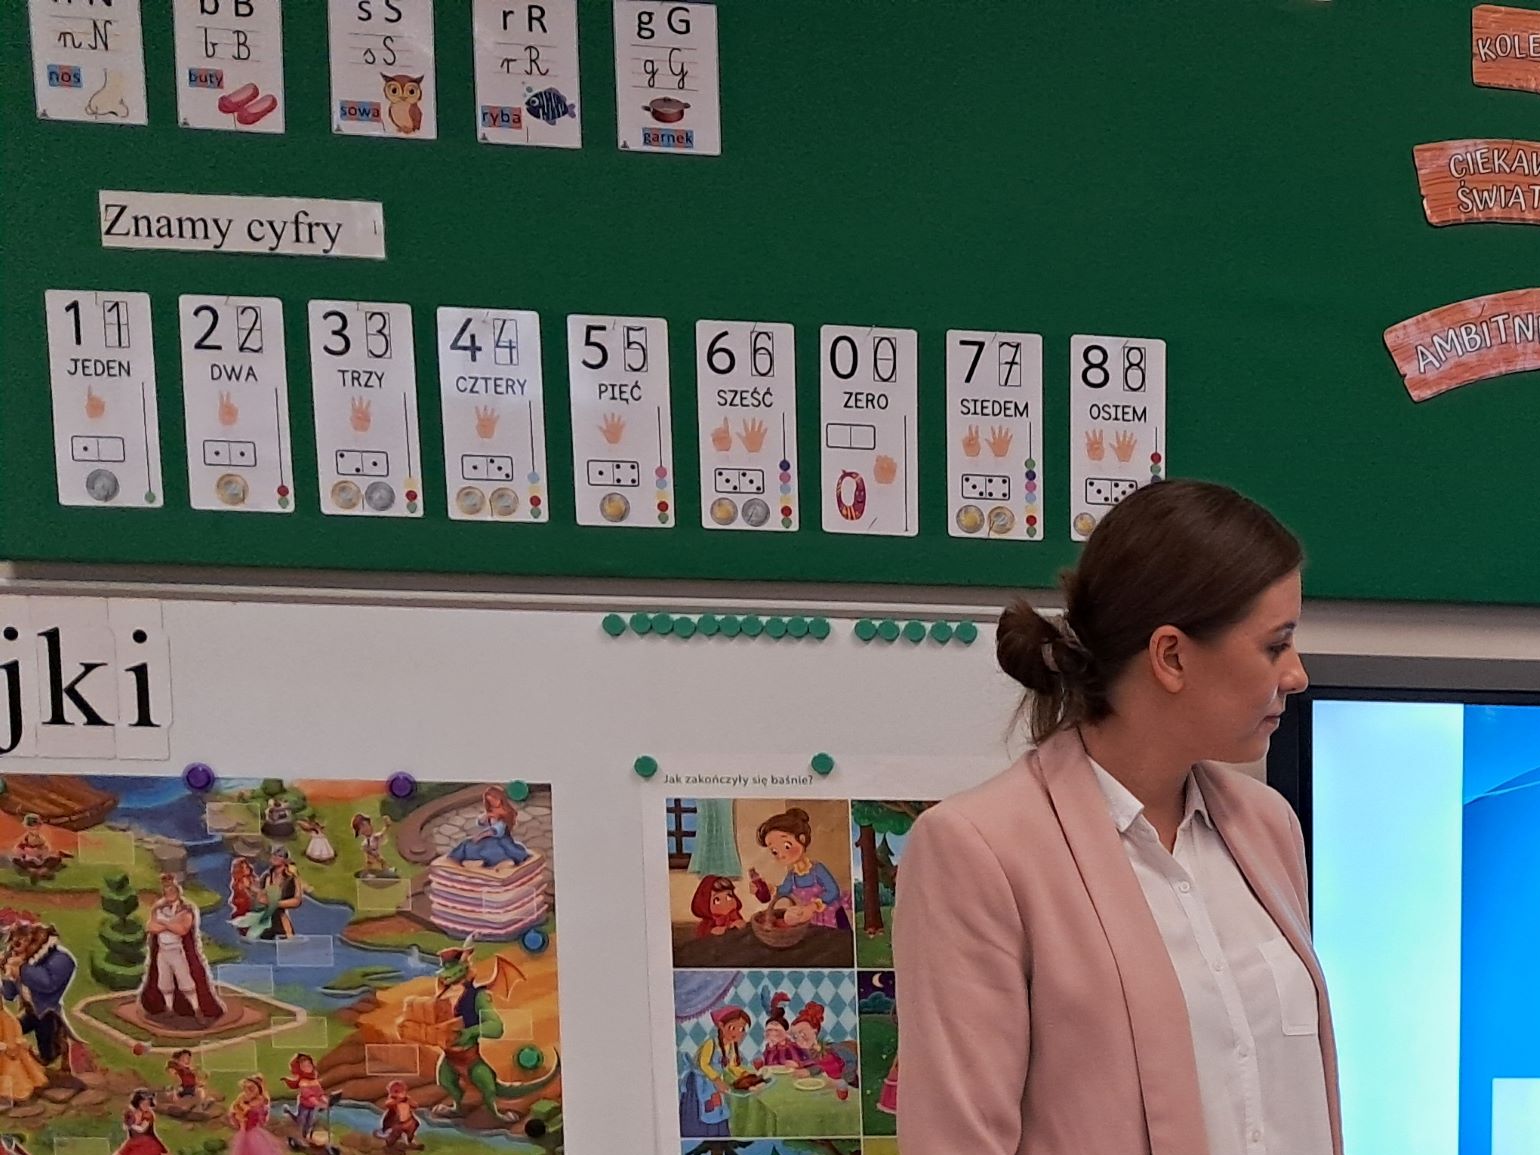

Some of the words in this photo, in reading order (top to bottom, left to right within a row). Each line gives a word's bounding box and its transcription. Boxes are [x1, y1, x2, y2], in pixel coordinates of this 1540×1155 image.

[502, 11, 514, 30] r
[528, 7, 548, 33] R
[637, 11, 655, 40] g
[667, 6, 691, 35] G
[49, 71, 81, 85] nos
[189, 70, 223, 88] buty
[340, 104, 380, 119] sowa
[482, 106, 521, 129] ryba
[643, 130, 693, 147] garnek
[103, 202, 234, 249] Znamy
[246, 211, 343, 253] cyfry
[65, 300, 81, 346] 1
[107, 301, 122, 348] 1
[193, 305, 222, 350] 2
[239, 306, 263, 352] 2
[323, 310, 351, 356] 3
[368, 312, 390, 358] 3
[450, 317, 482, 362] 4
[496, 319, 517, 364] 4
[581, 325, 608, 369] 5
[625, 327, 647, 370] 5
[706, 330, 736, 375] 6
[752, 331, 773, 376] 6
[830, 335, 858, 380] 0
[874, 337, 896, 382] 0
[959, 340, 985, 383] 7
[1000, 341, 1020, 385] 7
[67, 358, 132, 378] JEDEN
[210, 364, 258, 383] DWA
[338, 369, 385, 389] TRZY
[1081, 344, 1110, 389] 8
[1125, 347, 1145, 391] 8
[455, 376, 528, 396] CZTERY
[598, 382, 642, 405] PIĘĆ
[716, 387, 774, 409] SZEŚĆ
[843, 391, 889, 410] ZERO
[960, 397, 1029, 418] SIEDEM
[1088, 404, 1147, 423] OSIEM
[0, 626, 162, 754] jki
[664, 774, 682, 785] Jak
[685, 774, 749, 788] zakończyły
[751, 775, 768, 786] się
[771, 774, 813, 786] baśnie?
